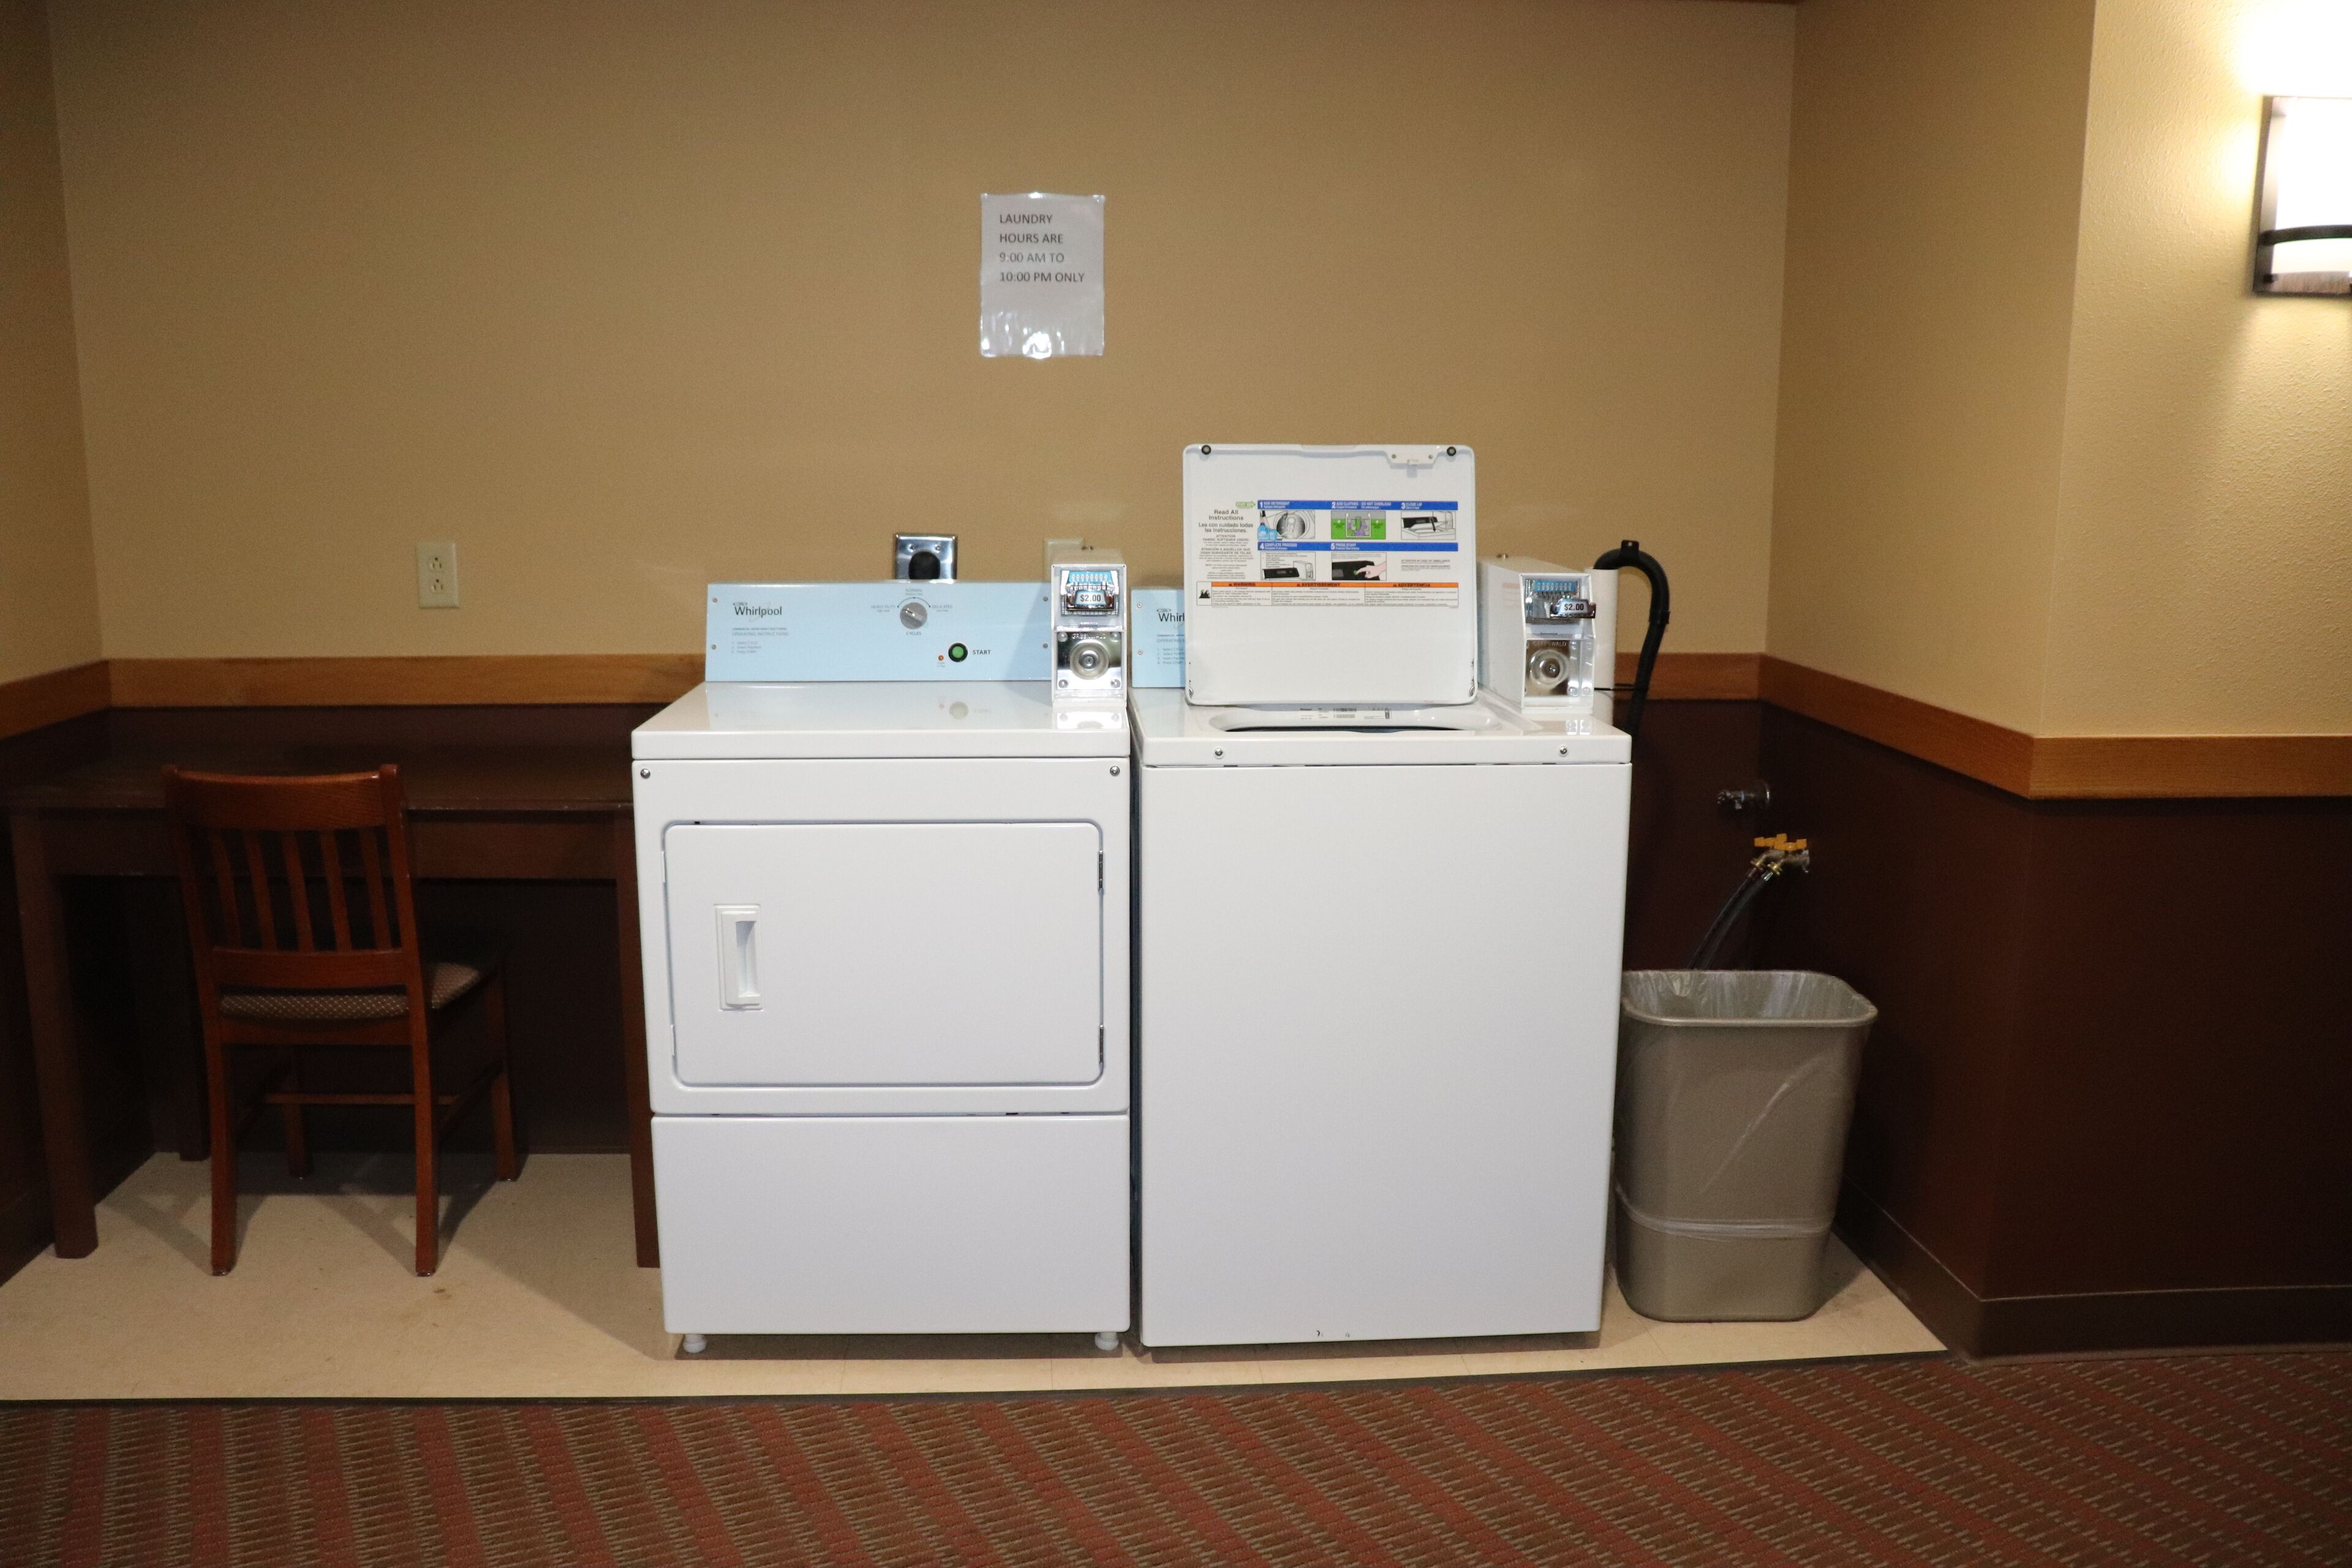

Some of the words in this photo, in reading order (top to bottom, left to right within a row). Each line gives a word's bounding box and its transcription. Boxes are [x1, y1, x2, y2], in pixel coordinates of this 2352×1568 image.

[1000, 214, 1053, 224] LAUNDRY
[1000, 233, 1039, 243] HOURS
[1042, 233, 1063, 243] ARE
[1000, 252, 1023, 263] 9:00
[1027, 252, 1046, 263] AM
[1049, 252, 1065, 263] TO
[1000, 272, 1031, 282] 10:00
[1034, 272, 1052, 282] PM
[1055, 272, 1085, 282] ONLY
[734, 606, 782, 618] Whirlpool
